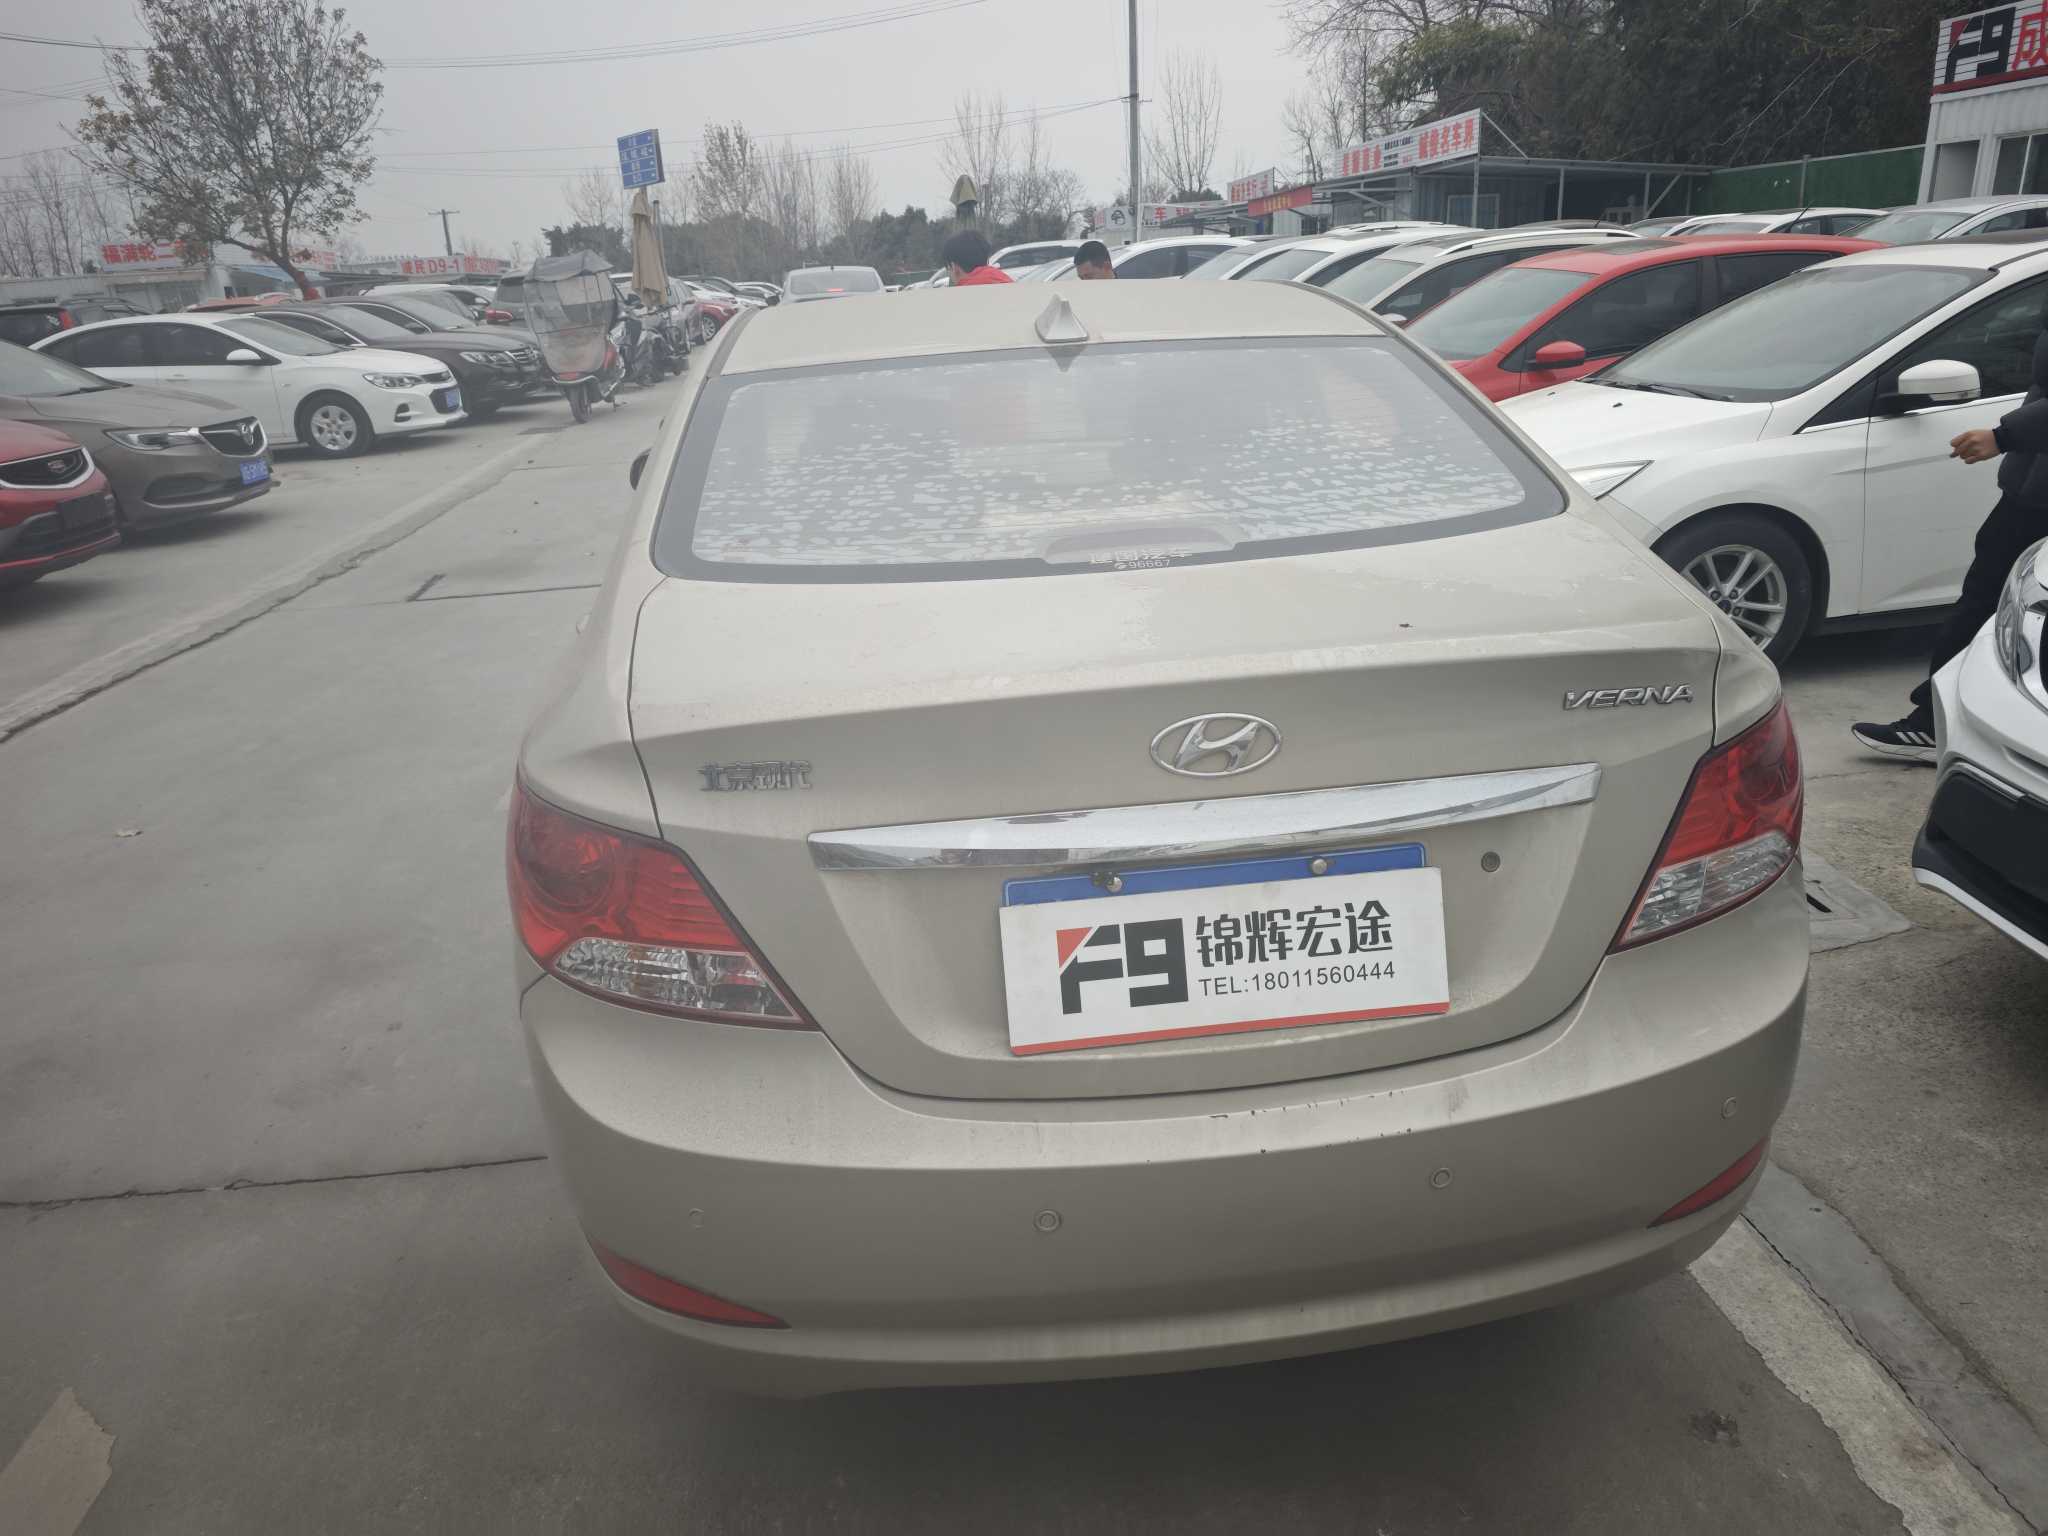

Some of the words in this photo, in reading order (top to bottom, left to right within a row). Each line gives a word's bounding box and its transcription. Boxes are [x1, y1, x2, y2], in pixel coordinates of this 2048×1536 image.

[1563, 683, 1693, 711] VERNA
[697, 760, 813, 791] 北京现代
[1195, 899, 1394, 968] 锦辉宏途
[1056, 917, 1189, 1015] F9
[1198, 961, 1395, 997] TEL:18011560444
